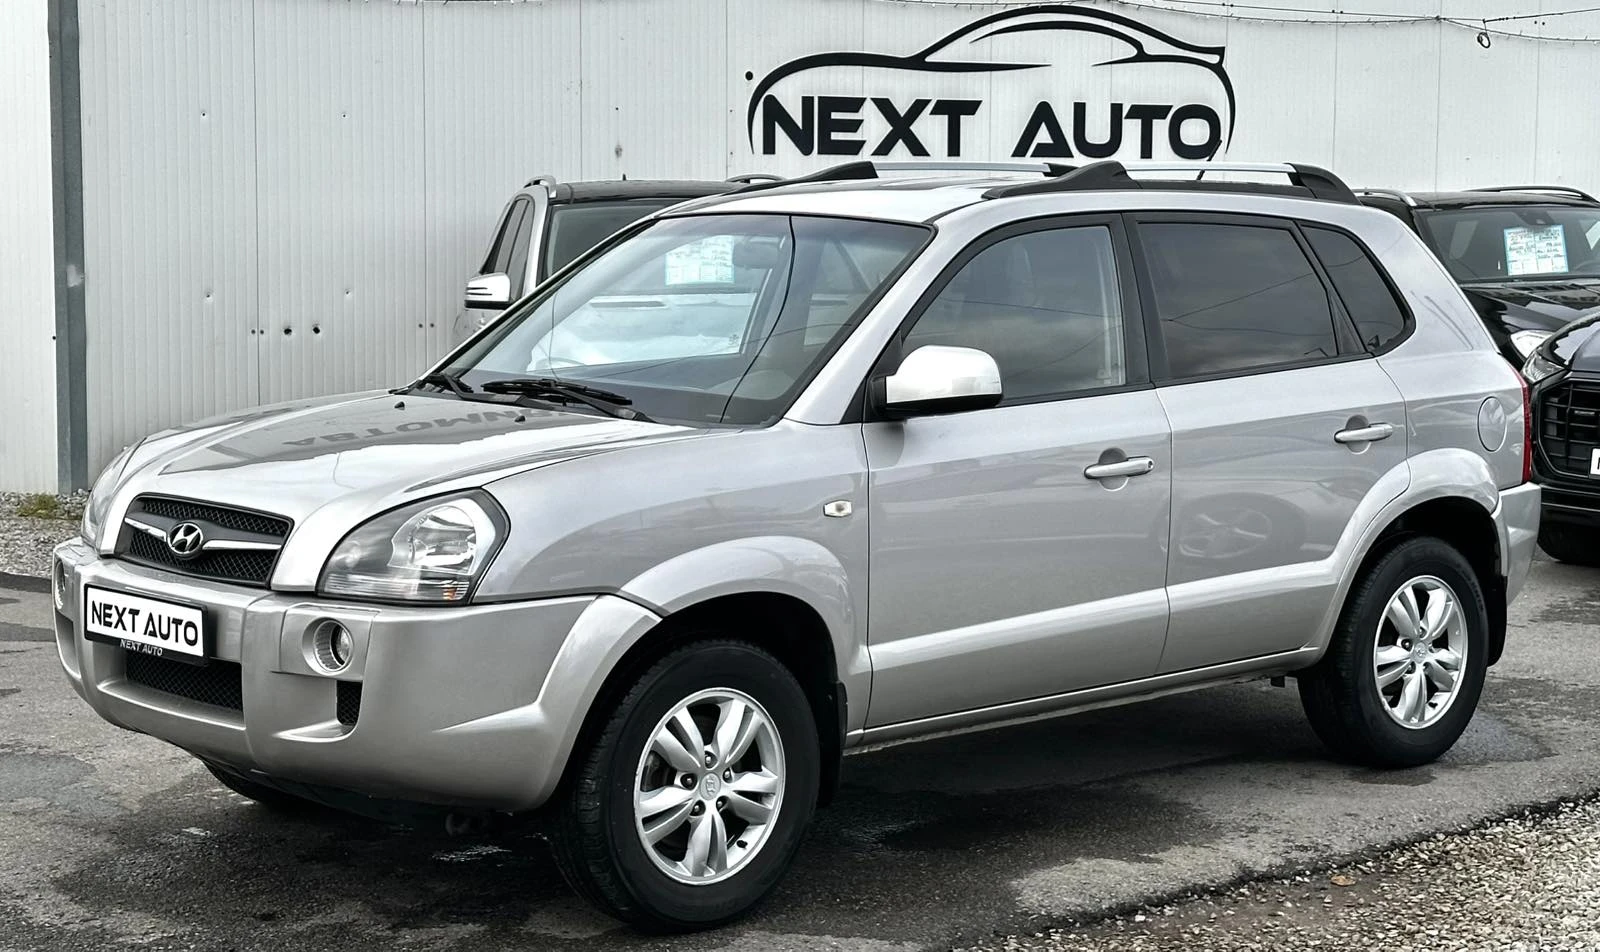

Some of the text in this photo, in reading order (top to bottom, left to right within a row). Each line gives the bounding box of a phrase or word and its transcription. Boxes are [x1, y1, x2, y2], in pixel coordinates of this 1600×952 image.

[763, 94, 1222, 160] NEXT AUTO
[92, 600, 198, 646] NEXT AUTO
[120, 639, 163, 656] NEXT AUTO
